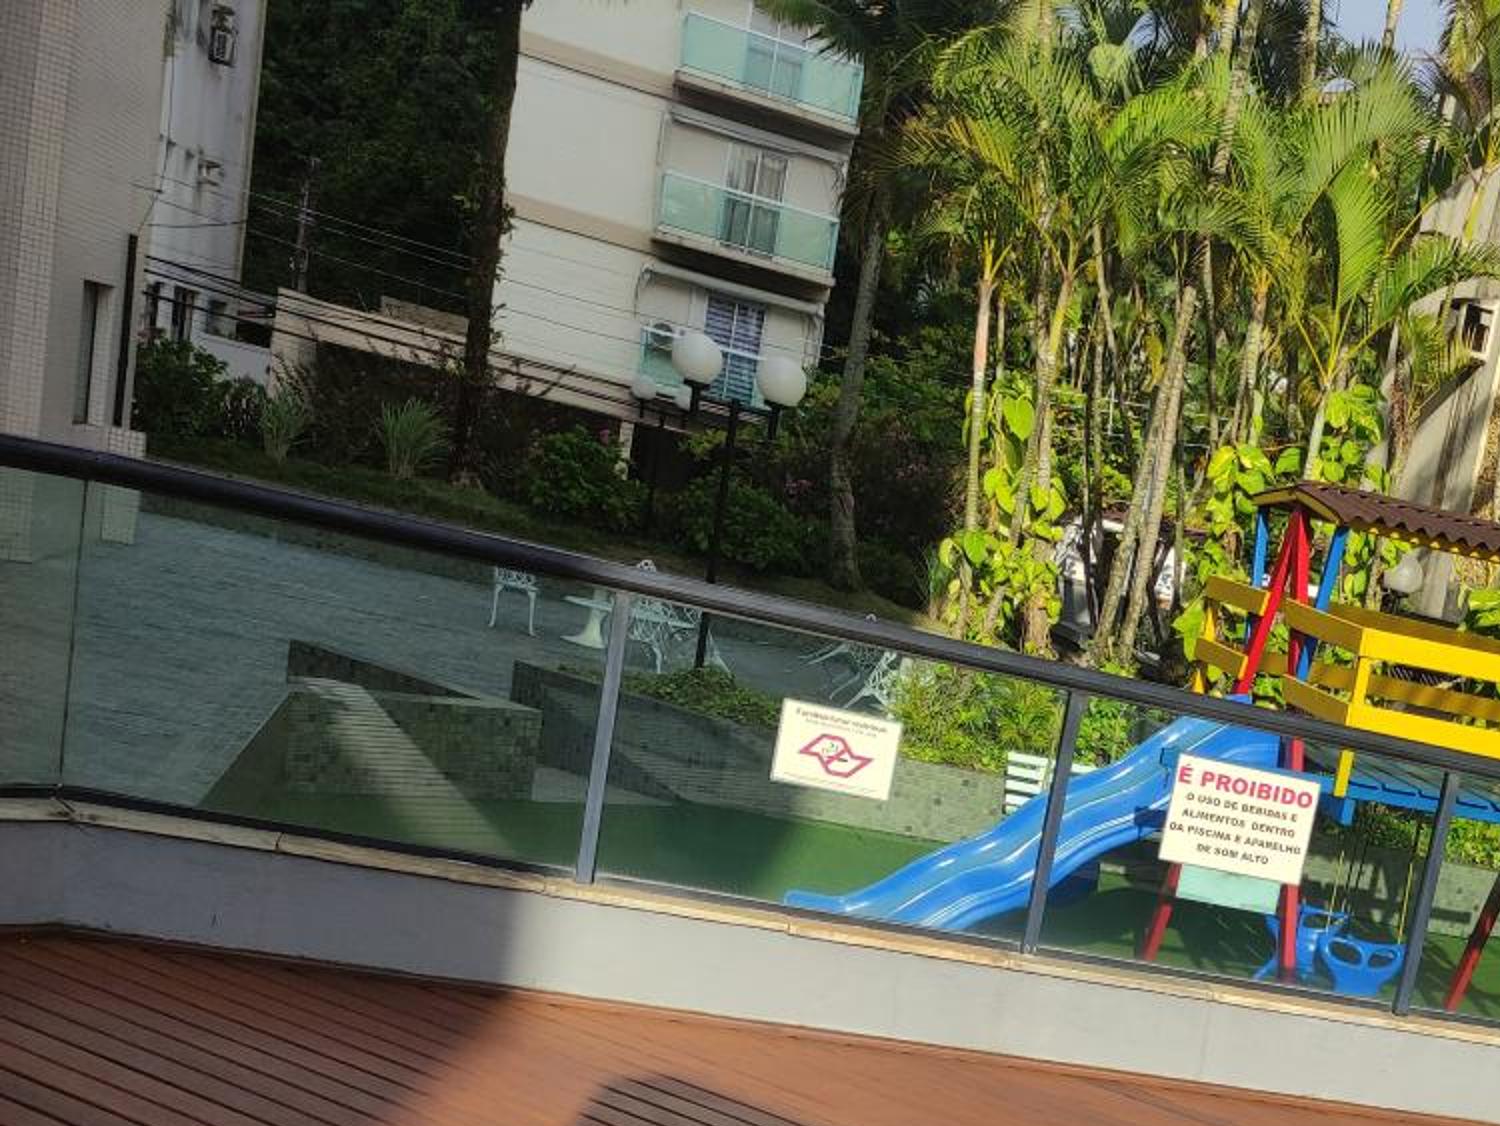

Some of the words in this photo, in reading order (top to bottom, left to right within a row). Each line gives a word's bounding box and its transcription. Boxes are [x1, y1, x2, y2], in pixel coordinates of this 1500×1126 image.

[1178, 764, 1193, 784] É
[1201, 771, 1313, 808] PROIBIDO
[1182, 808, 1245, 827] ALIMENTOS
[1251, 822, 1295, 838] DENTRO
[1198, 795, 1221, 807] USO
[1224, 800, 1239, 811] DE
[1241, 804, 1288, 821] BEBIDAS
[1169, 821, 1184, 832] DA
[1188, 825, 1231, 841] PISCINA
[1244, 837, 1301, 855] APARELHO
[1196, 843, 1210, 855] DE
[1213, 846, 1239, 858] SOM
[1240, 851, 1269, 865] ALTO
